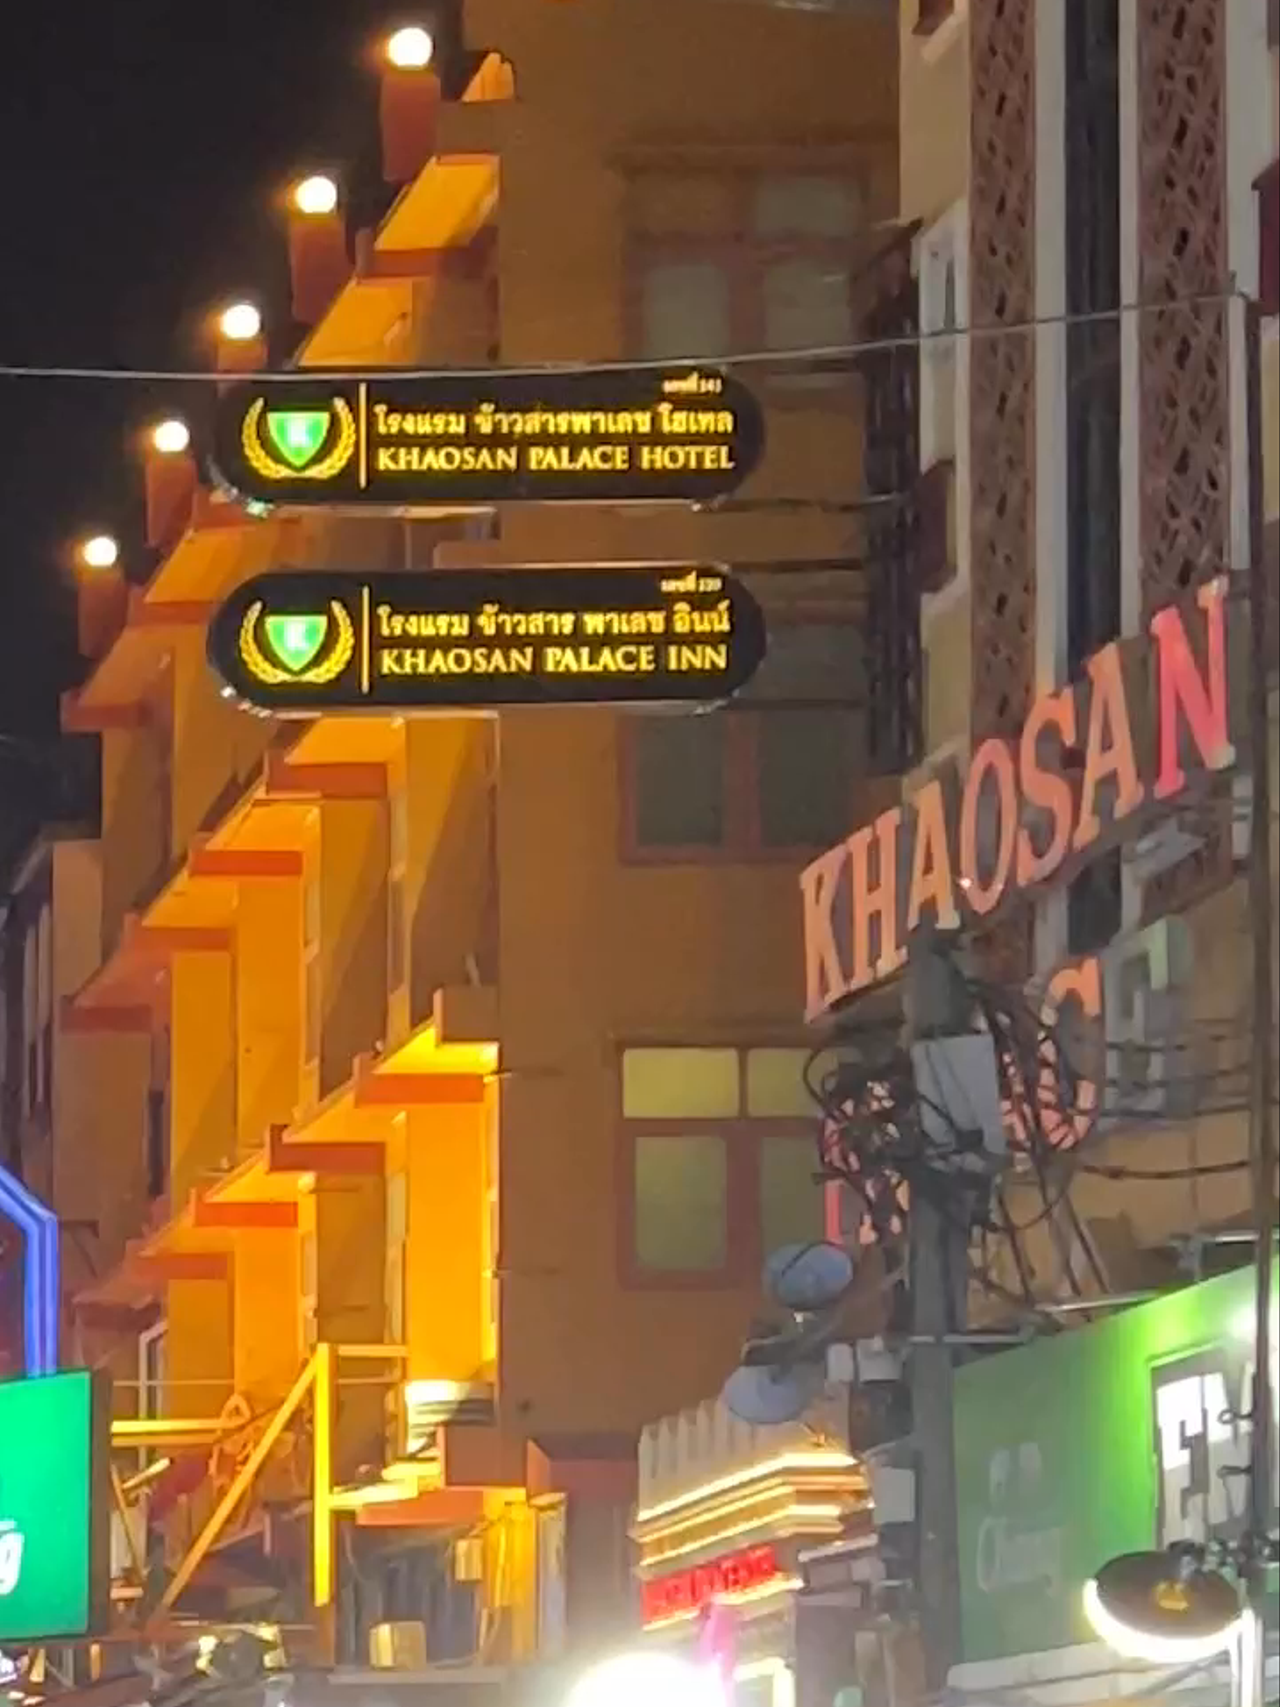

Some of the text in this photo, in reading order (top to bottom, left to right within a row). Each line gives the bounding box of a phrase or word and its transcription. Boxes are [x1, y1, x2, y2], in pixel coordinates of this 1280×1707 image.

[373, 403, 466, 435] โรงแรม
[377, 445, 735, 471] KHAOSAN PALACE HOTEL
[377, 605, 469, 637] โรงแรม
[379, 645, 727, 674] KHAOSAN PALACE INN
[798, 575, 1236, 1025] KHAOSAN
